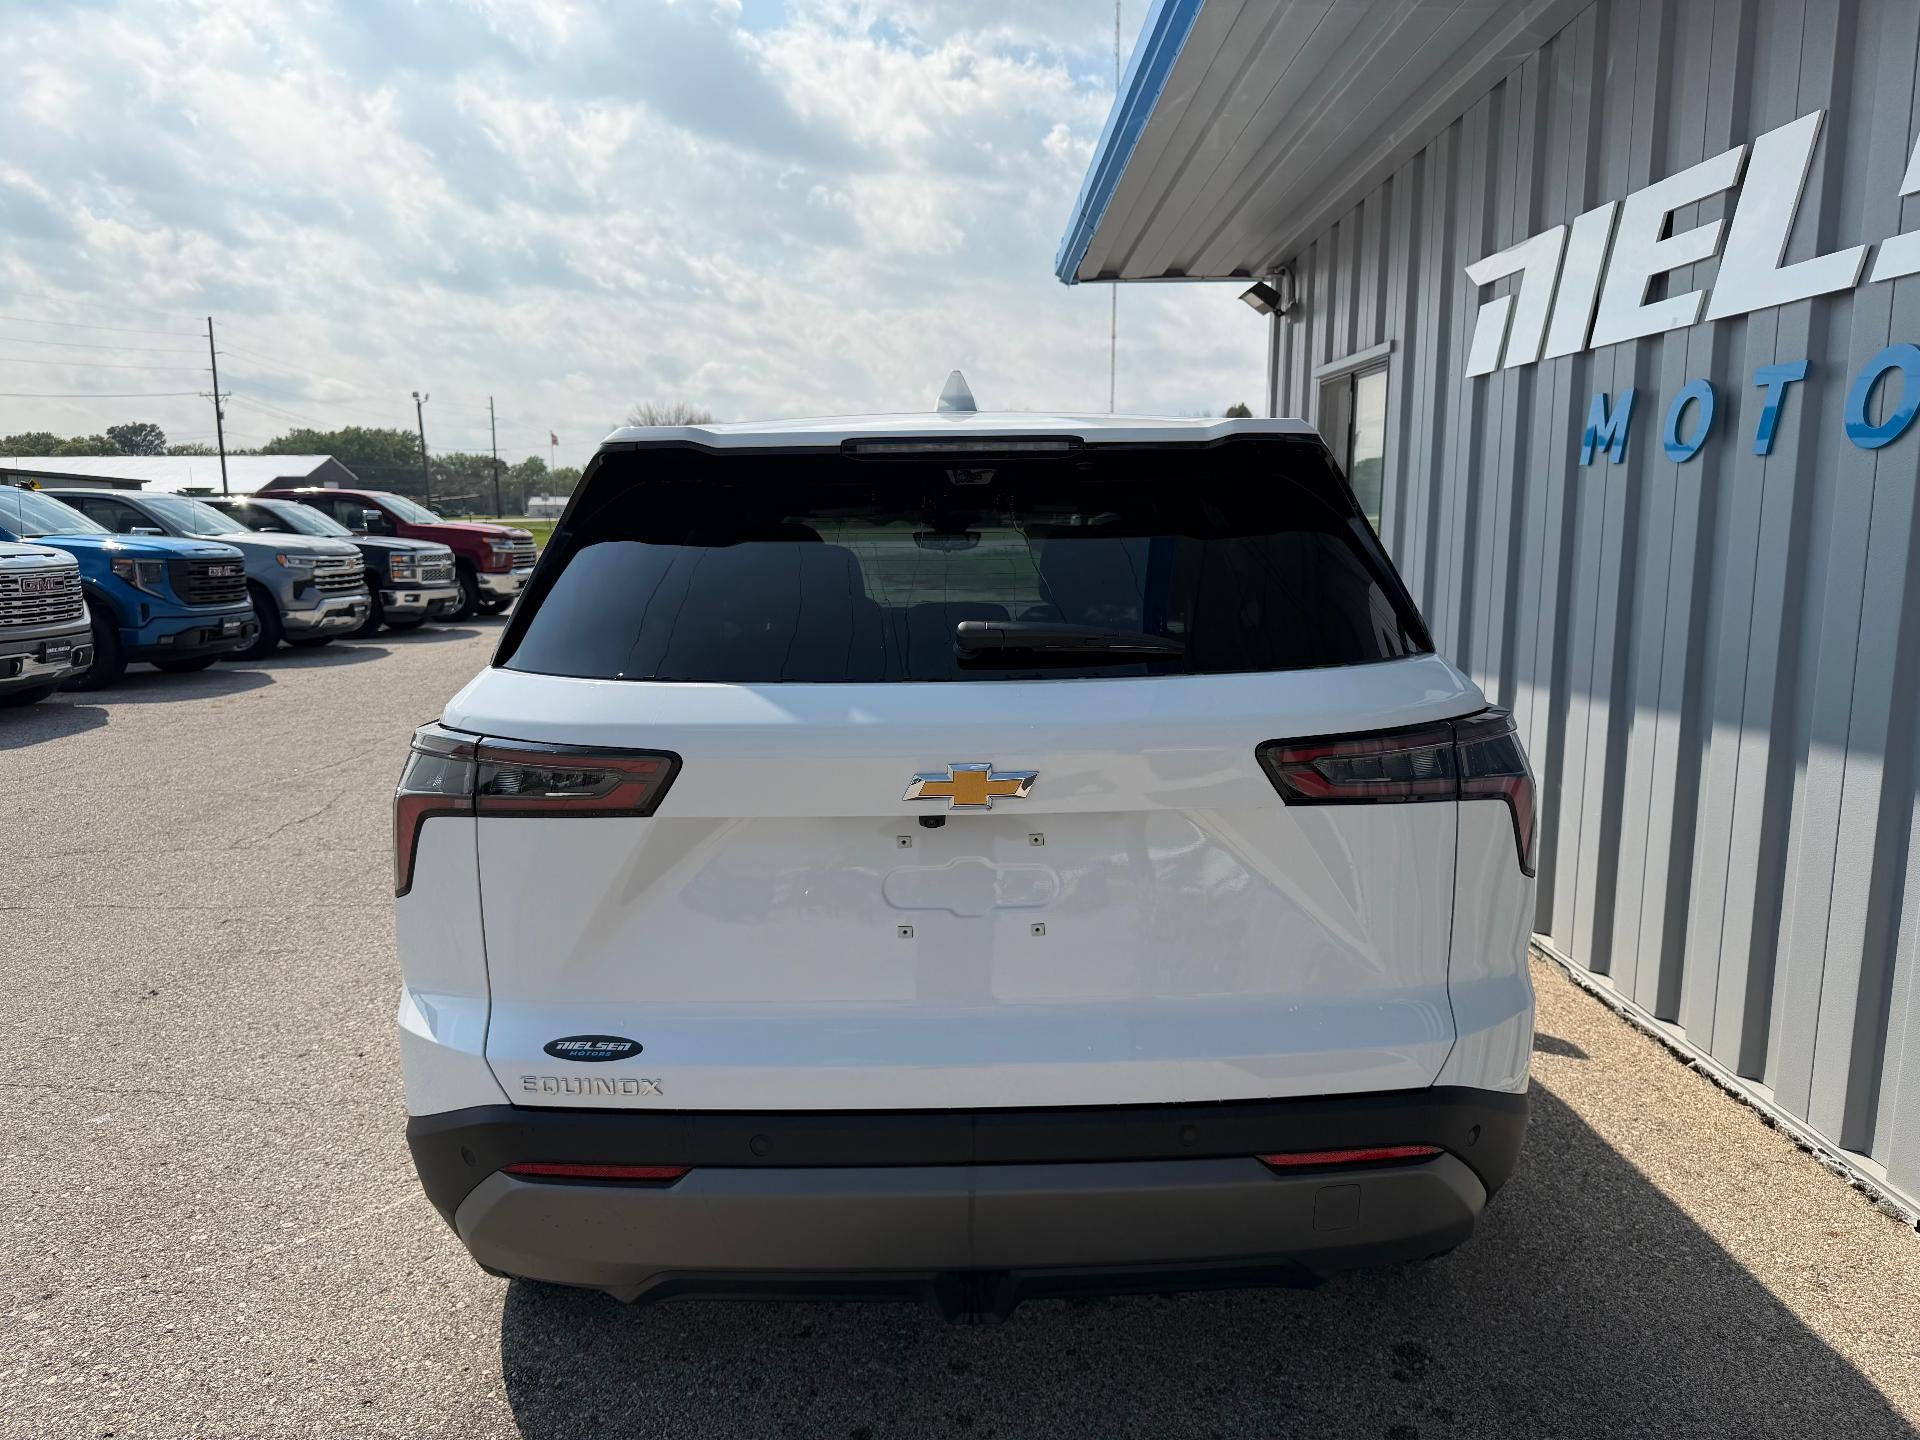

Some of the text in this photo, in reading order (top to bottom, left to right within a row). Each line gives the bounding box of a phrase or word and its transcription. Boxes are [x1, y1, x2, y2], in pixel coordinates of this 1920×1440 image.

[22, 576, 64, 592] GMC
[556, 1041, 632, 1051] NIELSEN
[520, 1075, 663, 1096] EQUINOX
